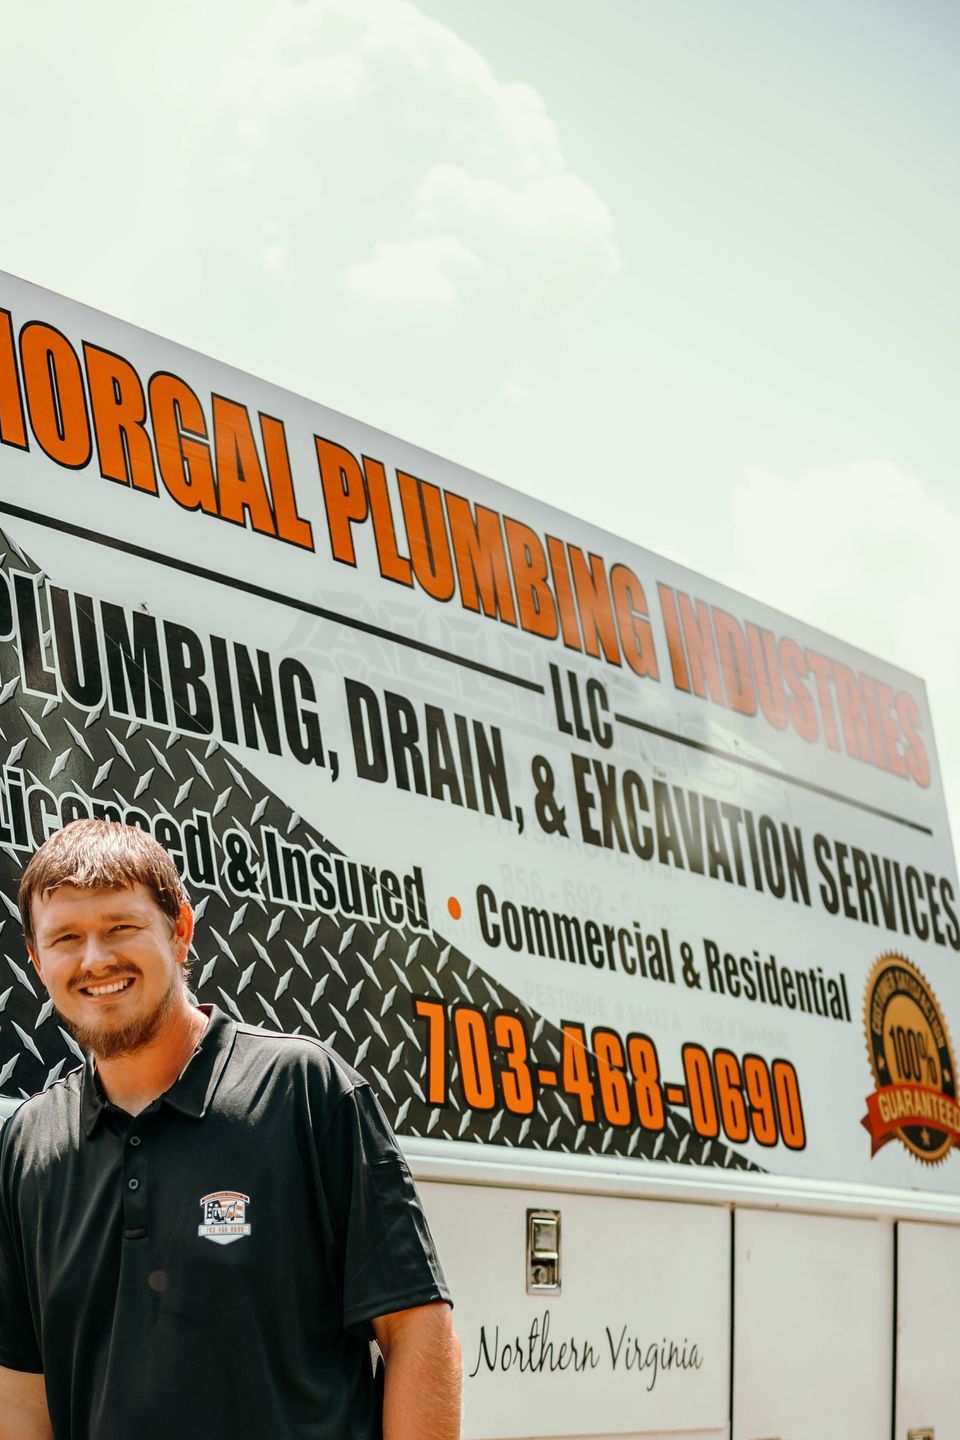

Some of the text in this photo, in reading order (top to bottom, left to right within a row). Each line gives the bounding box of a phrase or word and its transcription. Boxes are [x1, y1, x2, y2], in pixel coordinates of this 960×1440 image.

[313, 434, 660, 682] PLUMBING
[656, 581, 931, 790] INDUSTRIES
[549, 663, 614, 749] LLC
[344, 677, 524, 835] DRAIN,
[531, 755, 569, 838] &
[571, 752, 811, 907] EXCAVATION
[813, 833, 960, 951] SERVICES
[223, 828, 264, 900] &
[260, 825, 433, 936] Insured
[475, 884, 672, 997] Commercial
[681, 939, 703, 990] &
[703, 938, 852, 1023] Residential
[415, 998, 807, 1151] 703-468-0690
[889, 1025, 938, 1086] 100%
[469, 1310, 703, 1392] Northern Virginia
